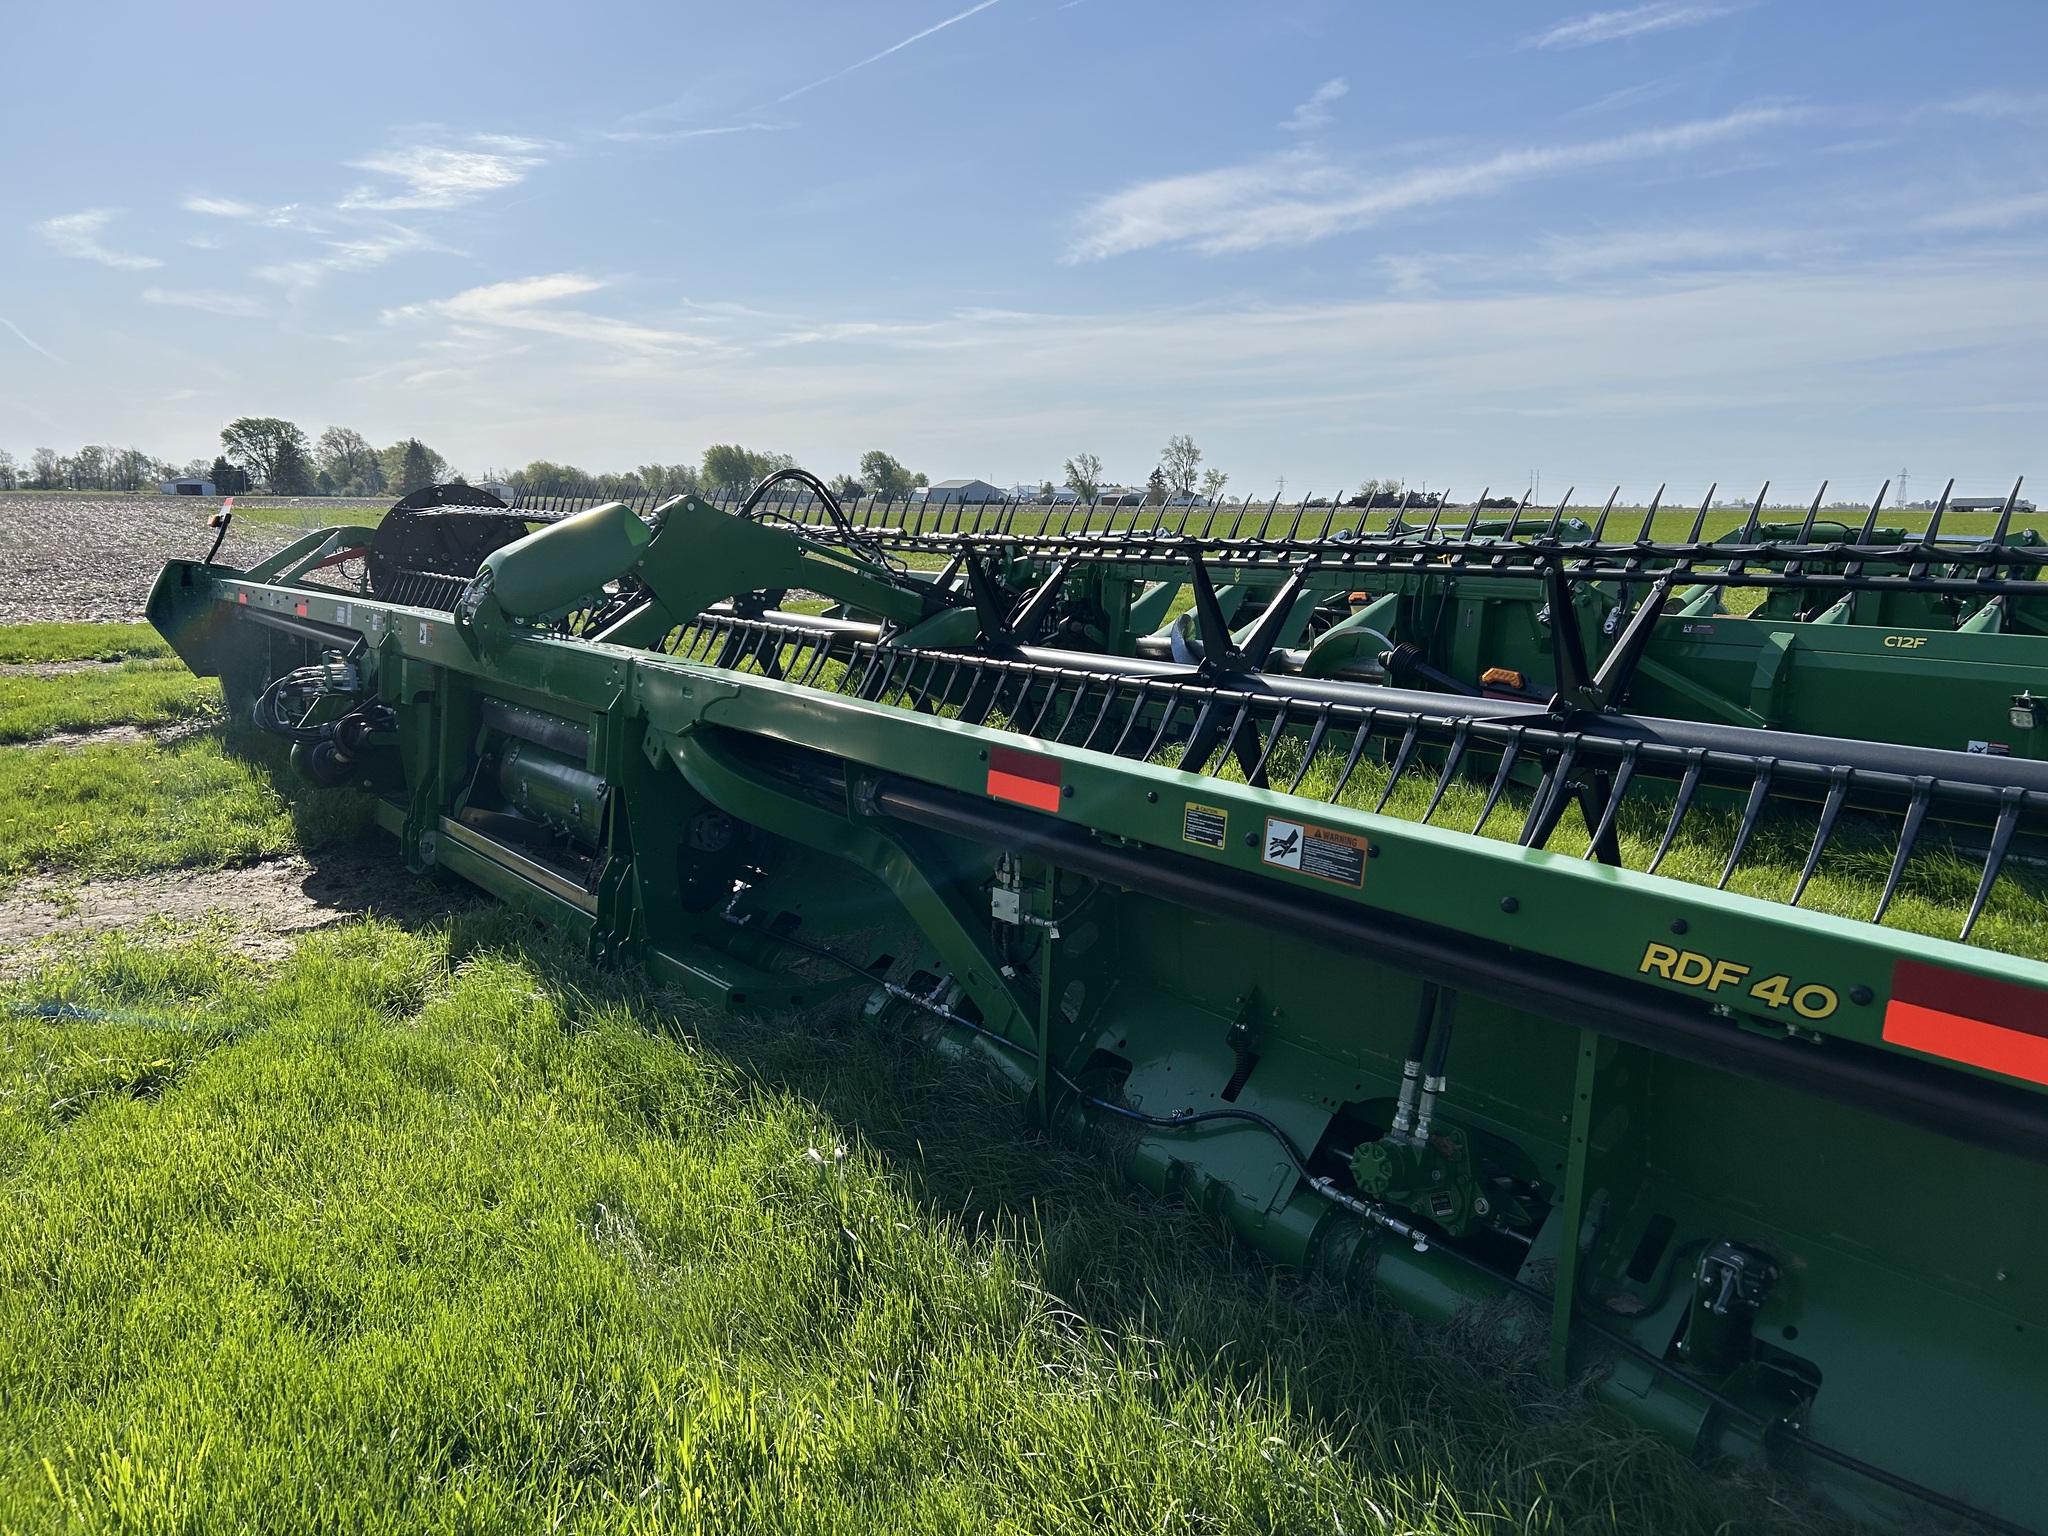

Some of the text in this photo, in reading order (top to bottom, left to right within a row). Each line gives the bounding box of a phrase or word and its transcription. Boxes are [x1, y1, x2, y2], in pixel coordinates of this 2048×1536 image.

[1884, 636, 1927, 648] C12F
[1323, 831, 1357, 847] WARNING
[1639, 942, 1838, 1019] RDF 40
